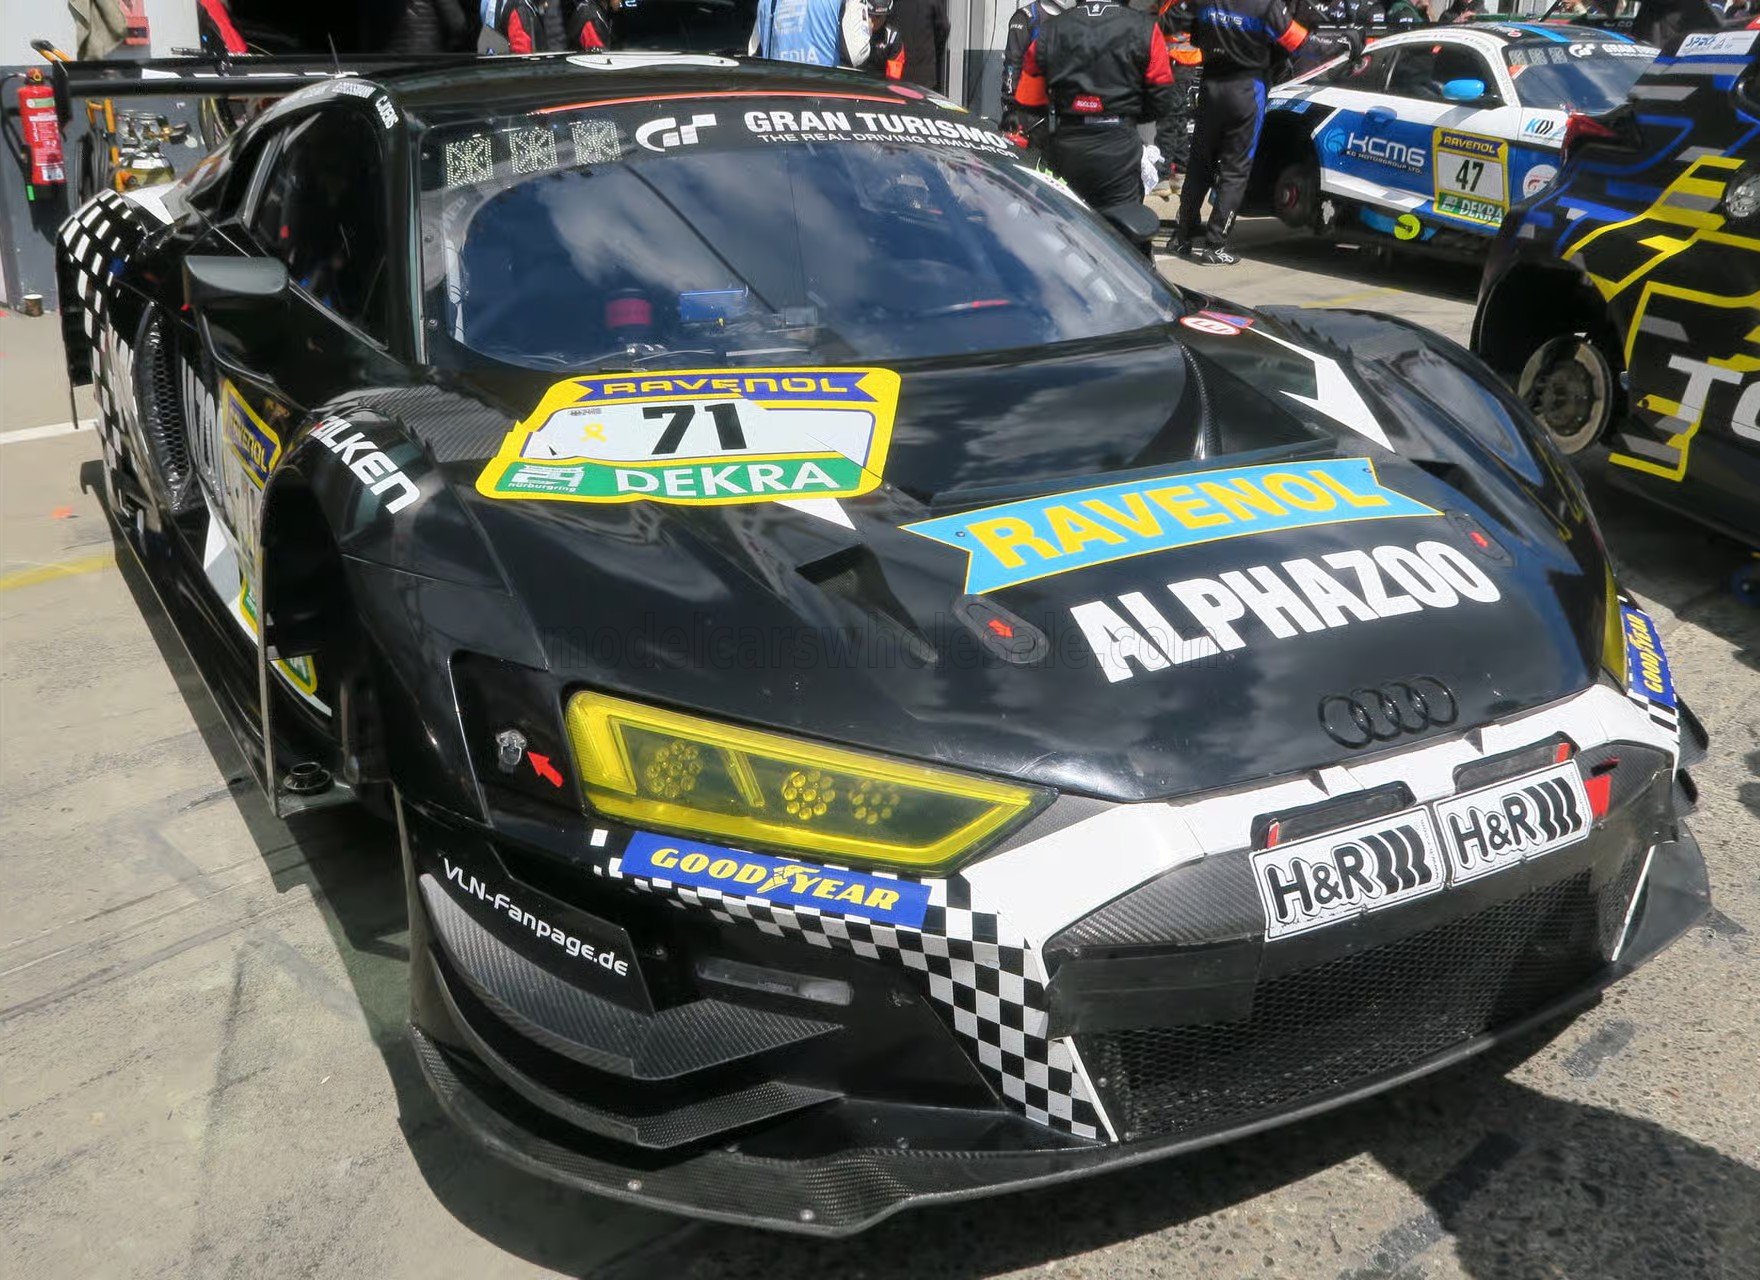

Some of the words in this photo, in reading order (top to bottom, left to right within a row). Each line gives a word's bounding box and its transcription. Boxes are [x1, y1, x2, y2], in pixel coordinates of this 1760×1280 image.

[743, 111, 851, 133] GRAN
[855, 112, 1008, 149] TURISMO
[757, 134, 799, 144] THE
[801, 132, 852, 142] REAL
[853, 133, 927, 144] DRIVING
[927, 137, 1019, 160] SIMULATOR
[1443, 136, 1496, 154] RAVENOL
[1347, 132, 1426, 167] KCMG
[1455, 159, 1484, 192] 47
[1460, 199, 1503, 224] DEKRA
[603, 377, 848, 396] RAVENOL
[642, 402, 747, 455] 71
[614, 461, 839, 497] DEKRA
[966, 470, 1392, 568] RAVENOL
[1070, 541, 1500, 683] ALPHAZOO
[1450, 794, 1537, 866] H&R
[1267, 845, 1374, 920] H&R
[444, 857, 629, 977] VLN-Fanpage.de
